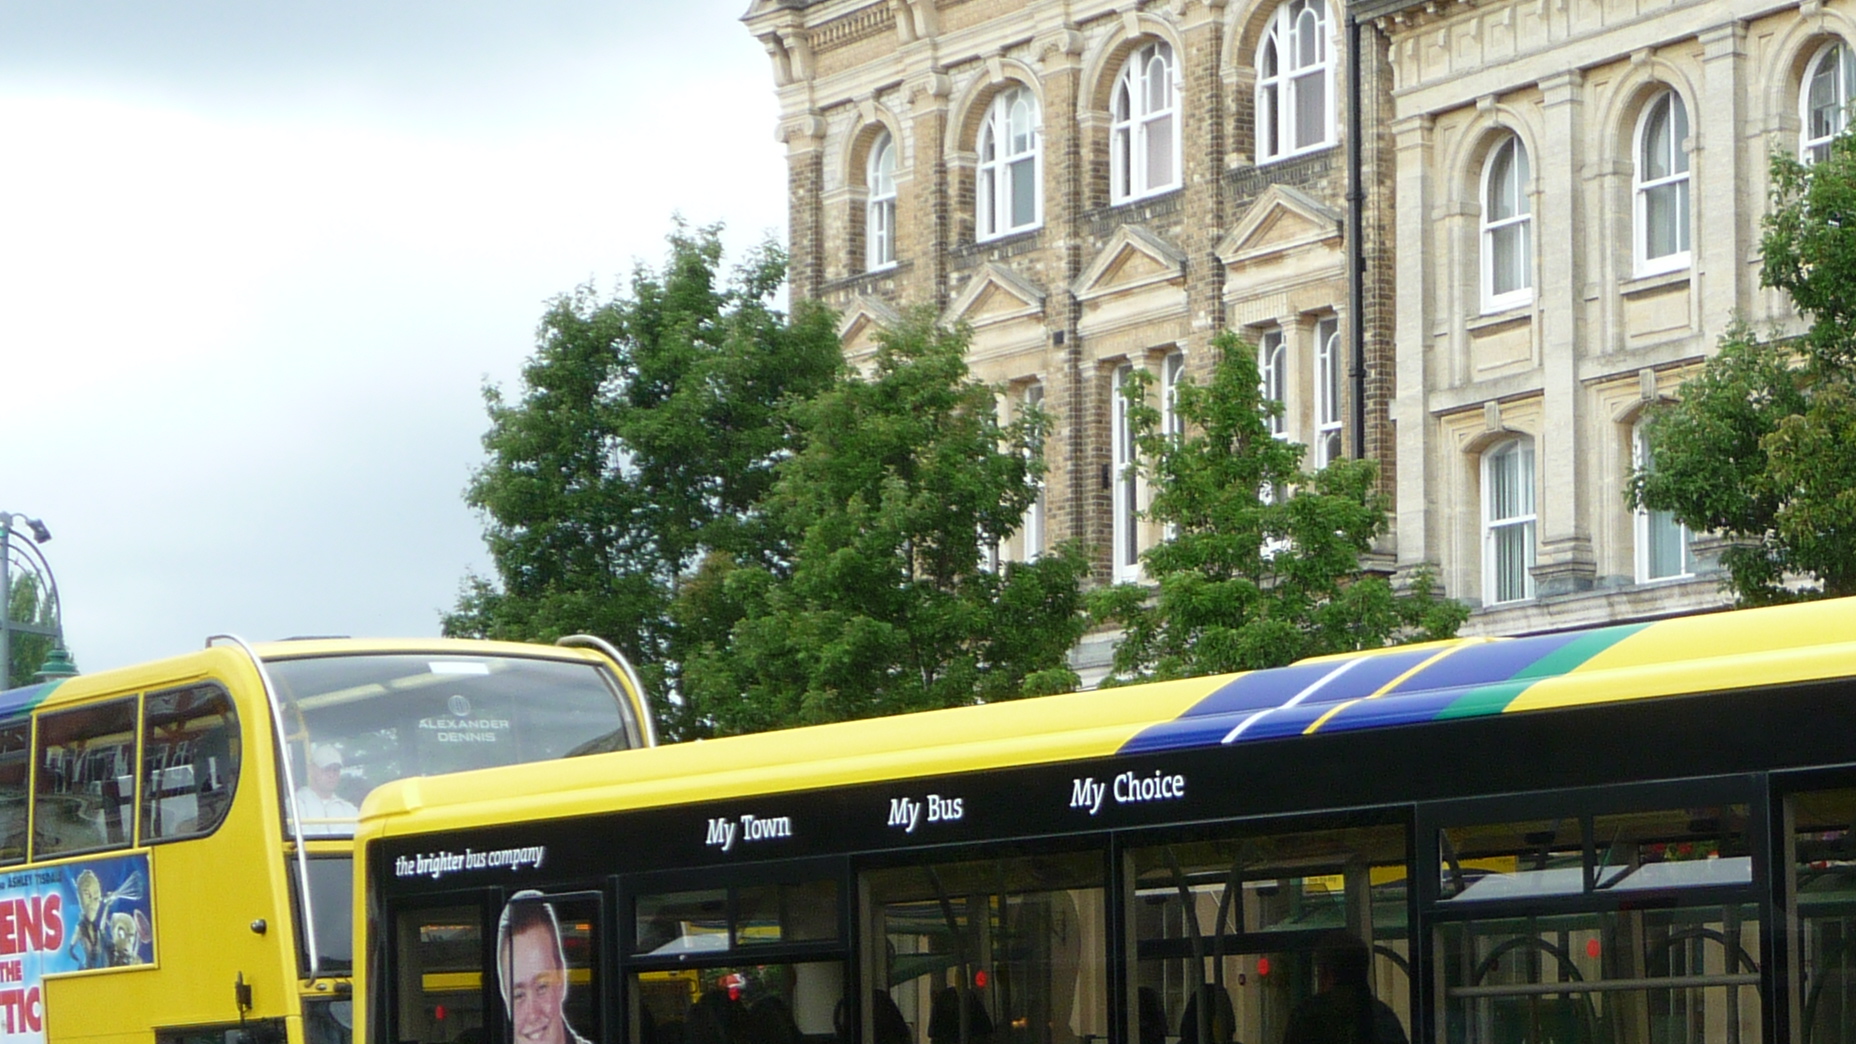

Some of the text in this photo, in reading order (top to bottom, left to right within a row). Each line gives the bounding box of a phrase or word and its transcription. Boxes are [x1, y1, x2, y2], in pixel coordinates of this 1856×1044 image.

[418, 718, 510, 730] ALEXANDER
[437, 732, 497, 742] DENNIS
[1070, 770, 1186, 815] My Choice
[888, 794, 963, 832] My Bus
[705, 815, 792, 851] My Town
[395, 845, 546, 879] the brighter bus company
[8, 873, 33, 889] ASHLEY
[0, 960, 22, 983] THE
